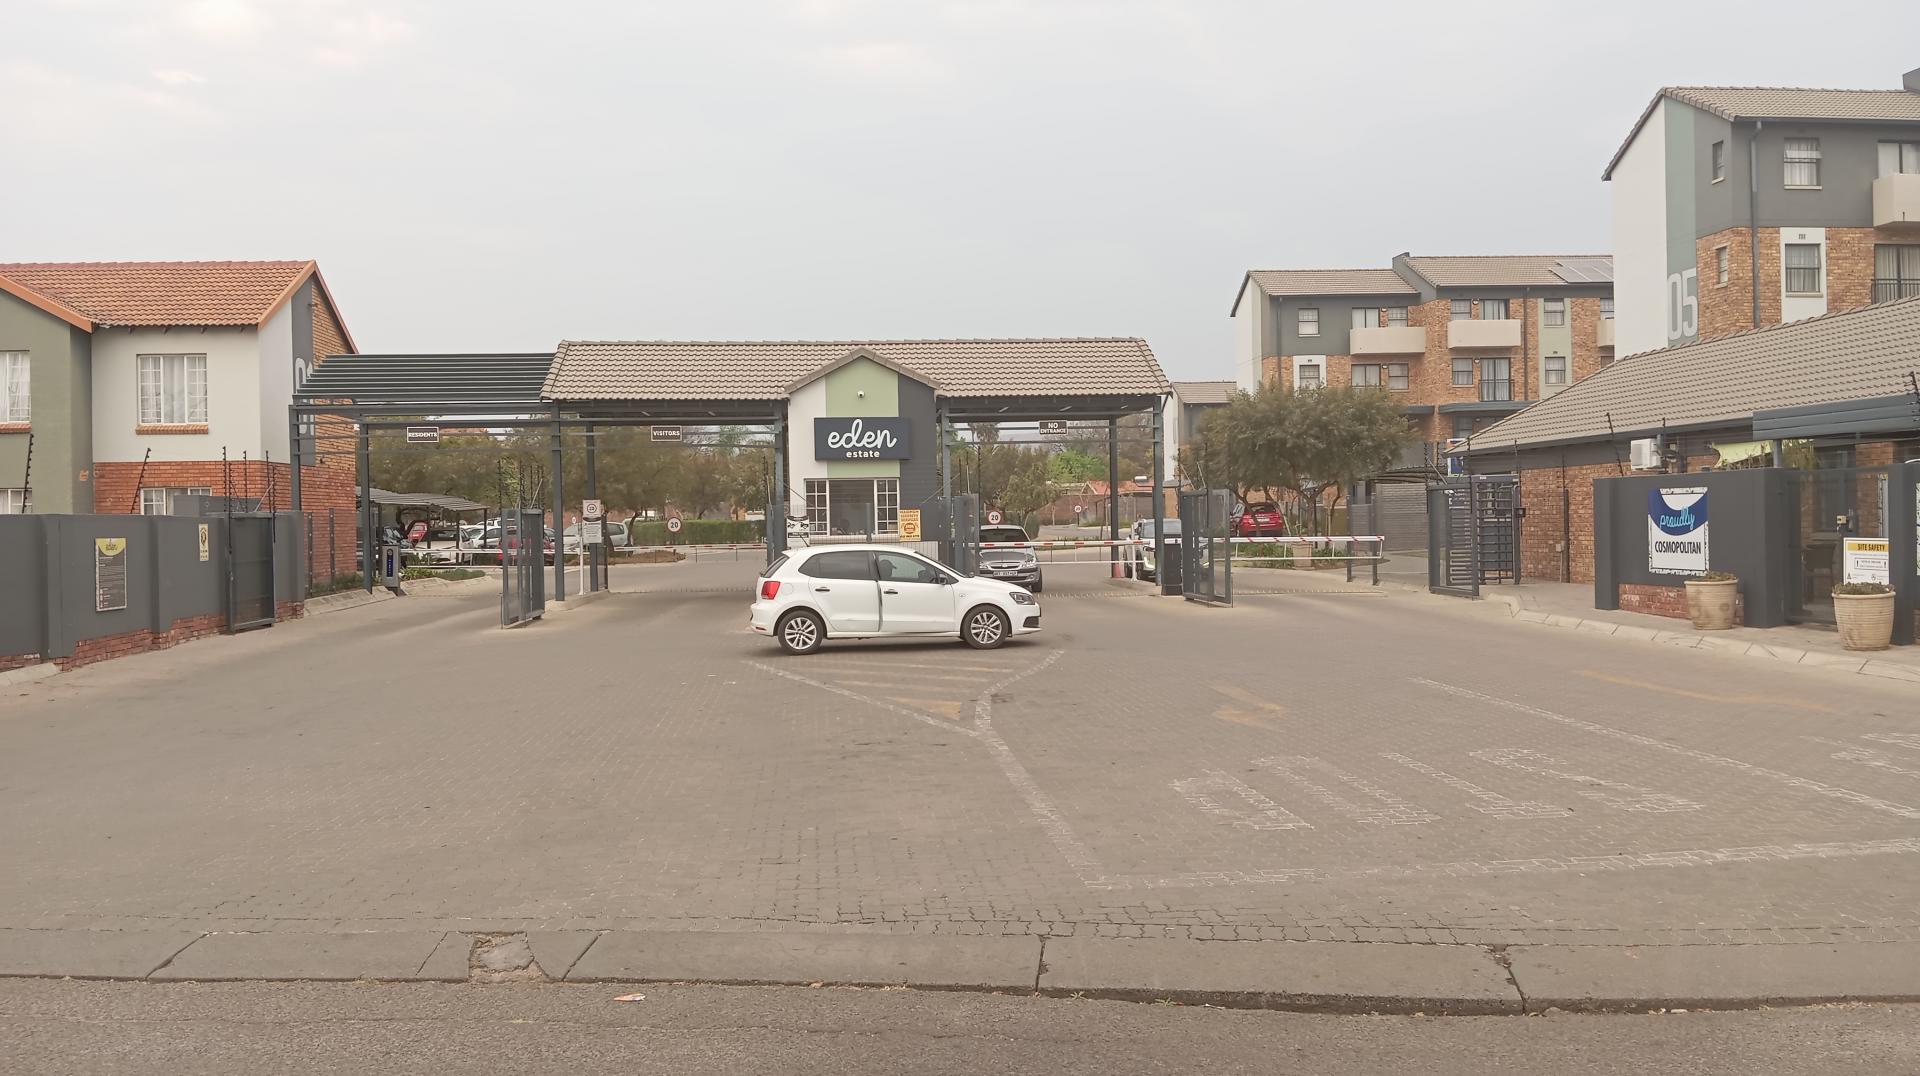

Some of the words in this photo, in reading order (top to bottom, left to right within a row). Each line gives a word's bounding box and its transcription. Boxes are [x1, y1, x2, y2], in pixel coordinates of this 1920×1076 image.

[1667, 267, 1699, 341] 05
[828, 418, 898, 448] eden
[846, 450, 880, 458] estate
[670, 521, 679, 529] 20
[1654, 540, 1702, 554] COSMOPOLITAN
[1857, 543, 1867, 551] SITE
[1868, 543, 1886, 552] SAFETY
